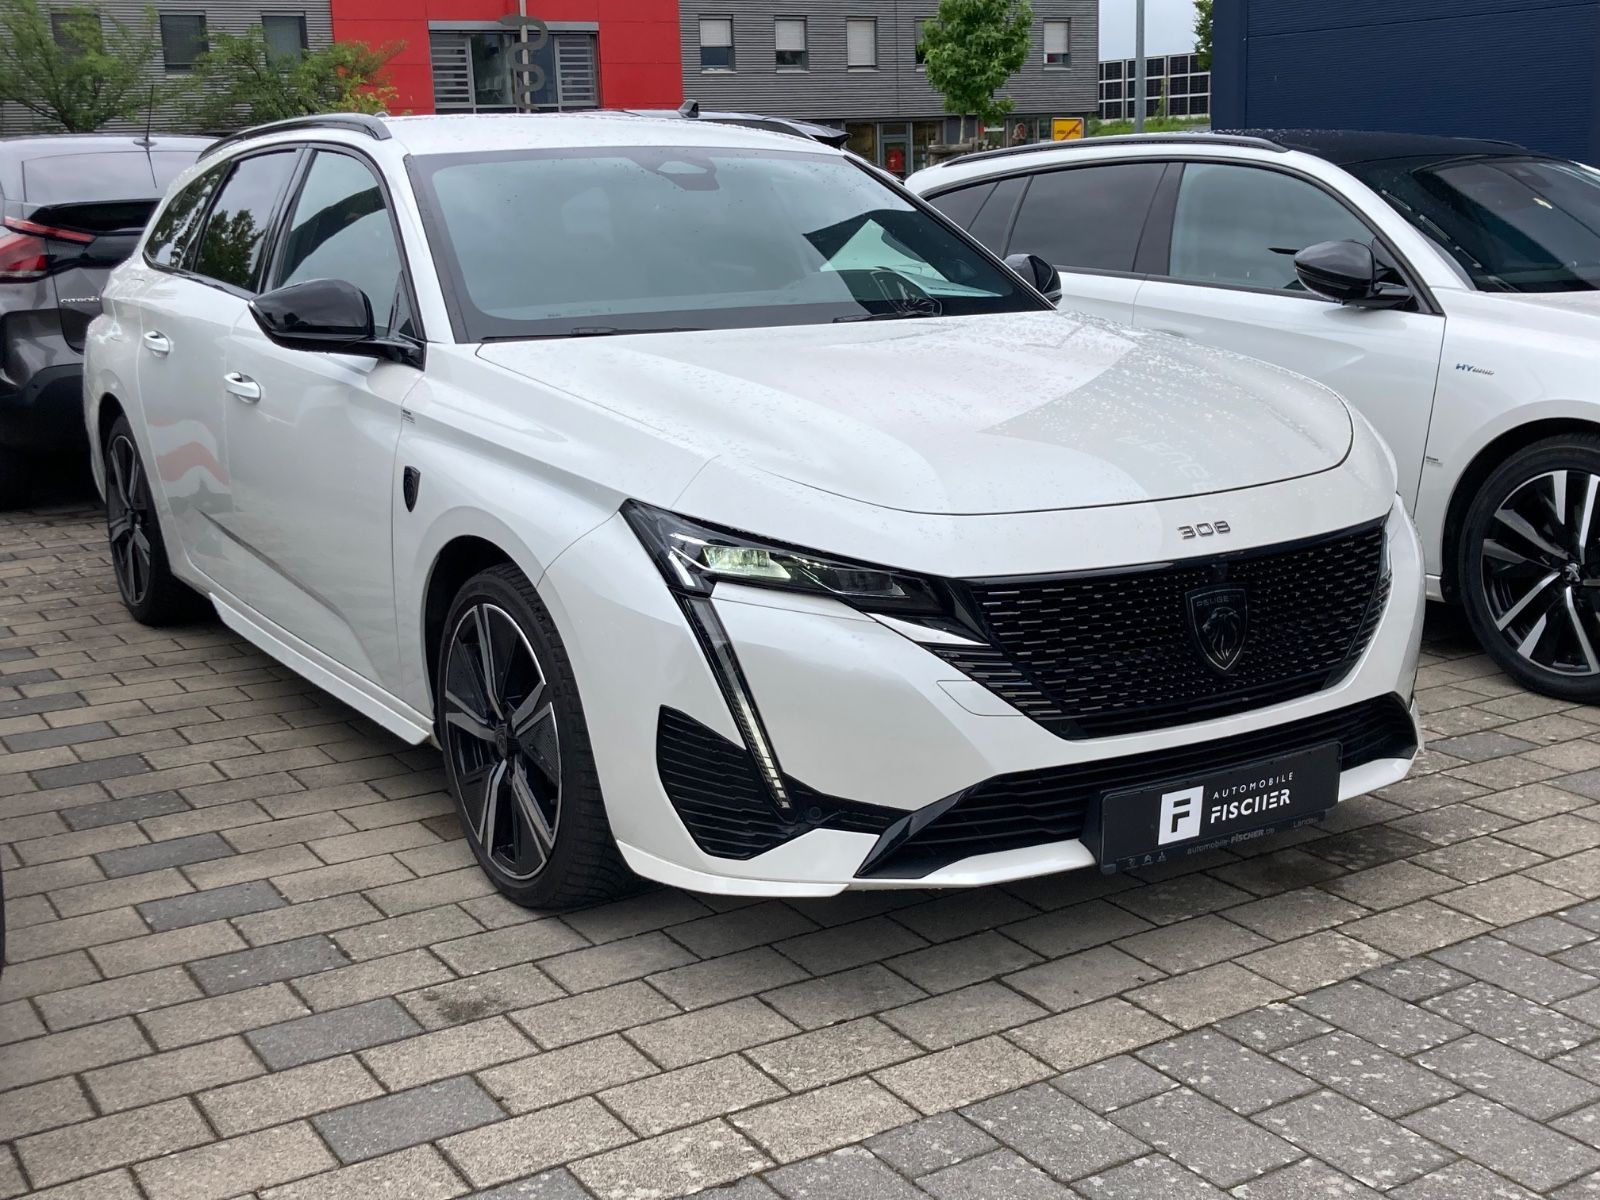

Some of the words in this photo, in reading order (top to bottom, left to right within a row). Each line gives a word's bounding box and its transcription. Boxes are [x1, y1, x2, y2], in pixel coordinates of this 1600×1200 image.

[1177, 520, 1231, 540] 308
[1212, 771, 1295, 800] AUTOMOBILE
[1210, 788, 1292, 824] FISCHER
